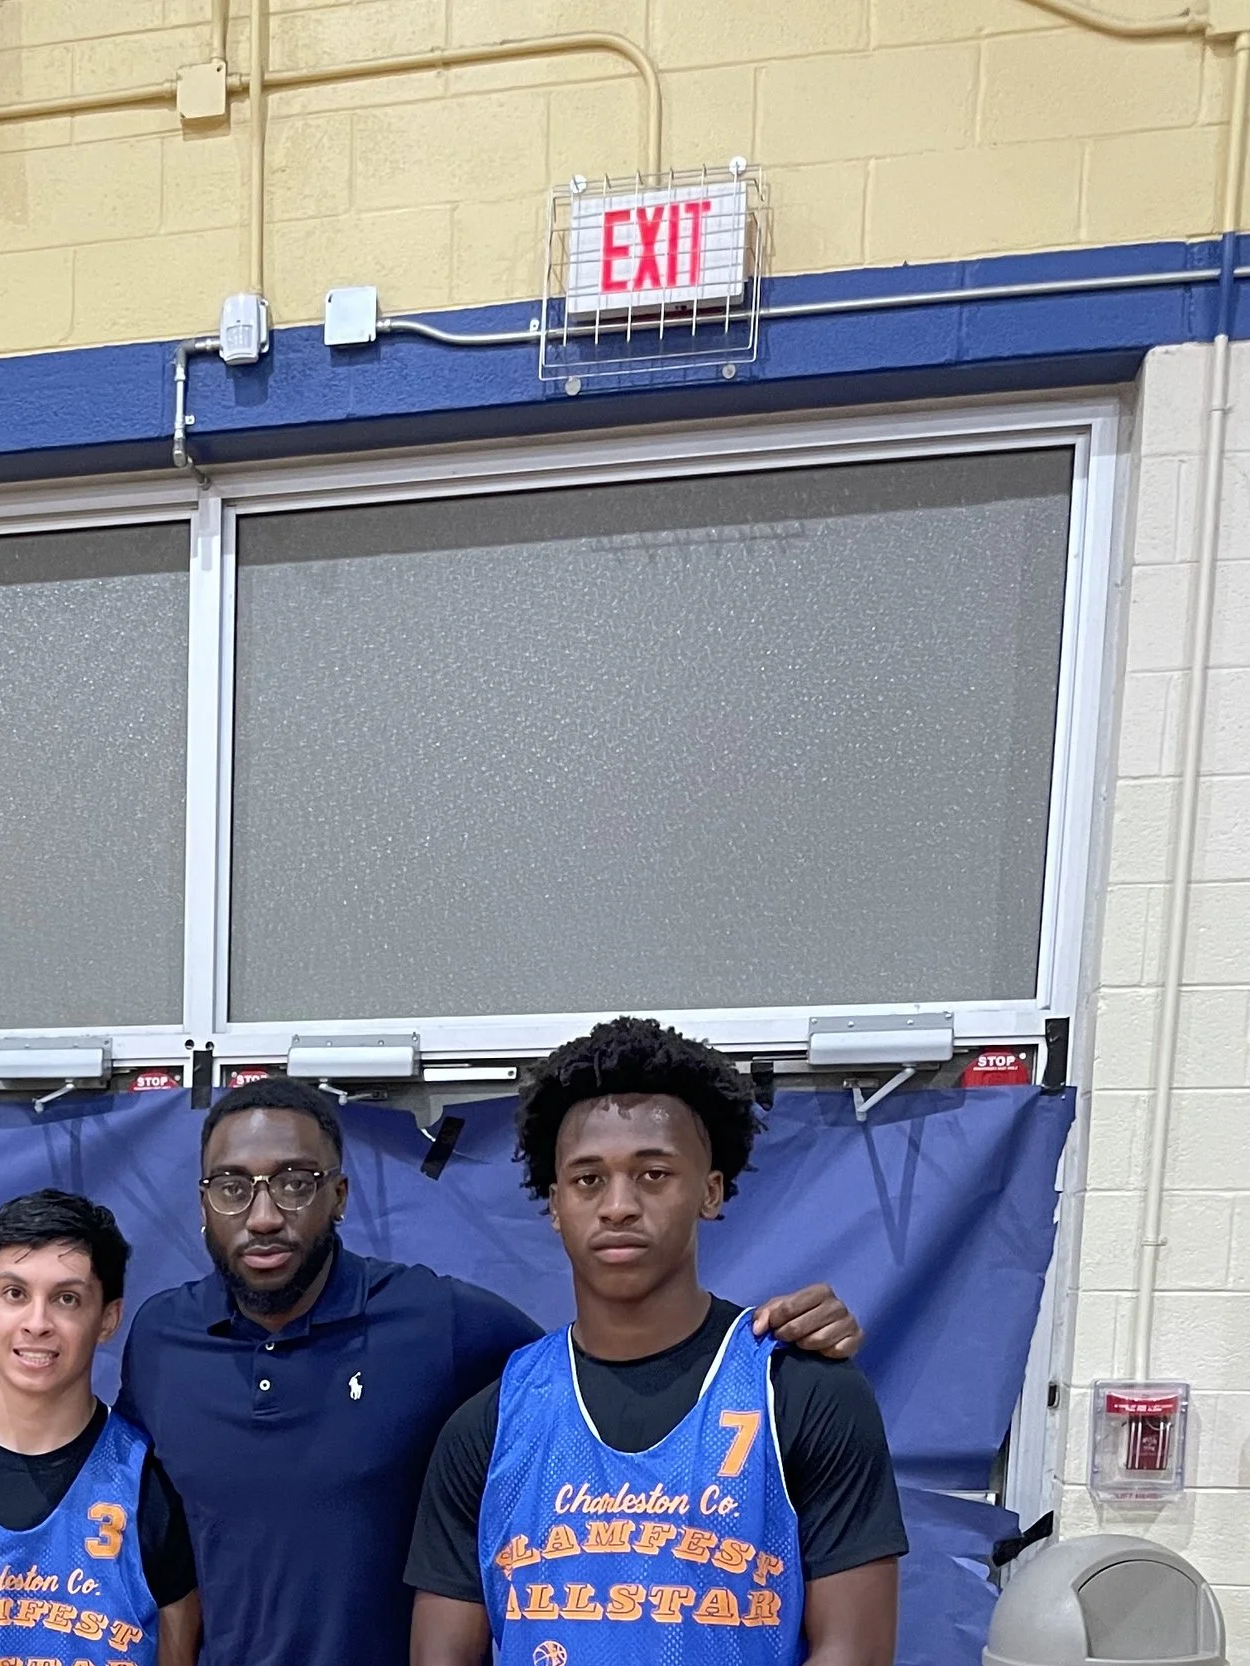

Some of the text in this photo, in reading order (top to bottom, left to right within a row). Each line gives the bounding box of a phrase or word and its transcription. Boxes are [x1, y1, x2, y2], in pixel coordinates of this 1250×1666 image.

[601, 200, 711, 292] EXIT
[978, 1055, 1016, 1067] STOP
[136, 1076, 169, 1087] STOP
[719, 1410, 762, 1477] 7
[555, 1482, 741, 1517] Charleston Co.
[84, 1502, 127, 1560] 3
[66, 1569, 102, 1597] Co.
